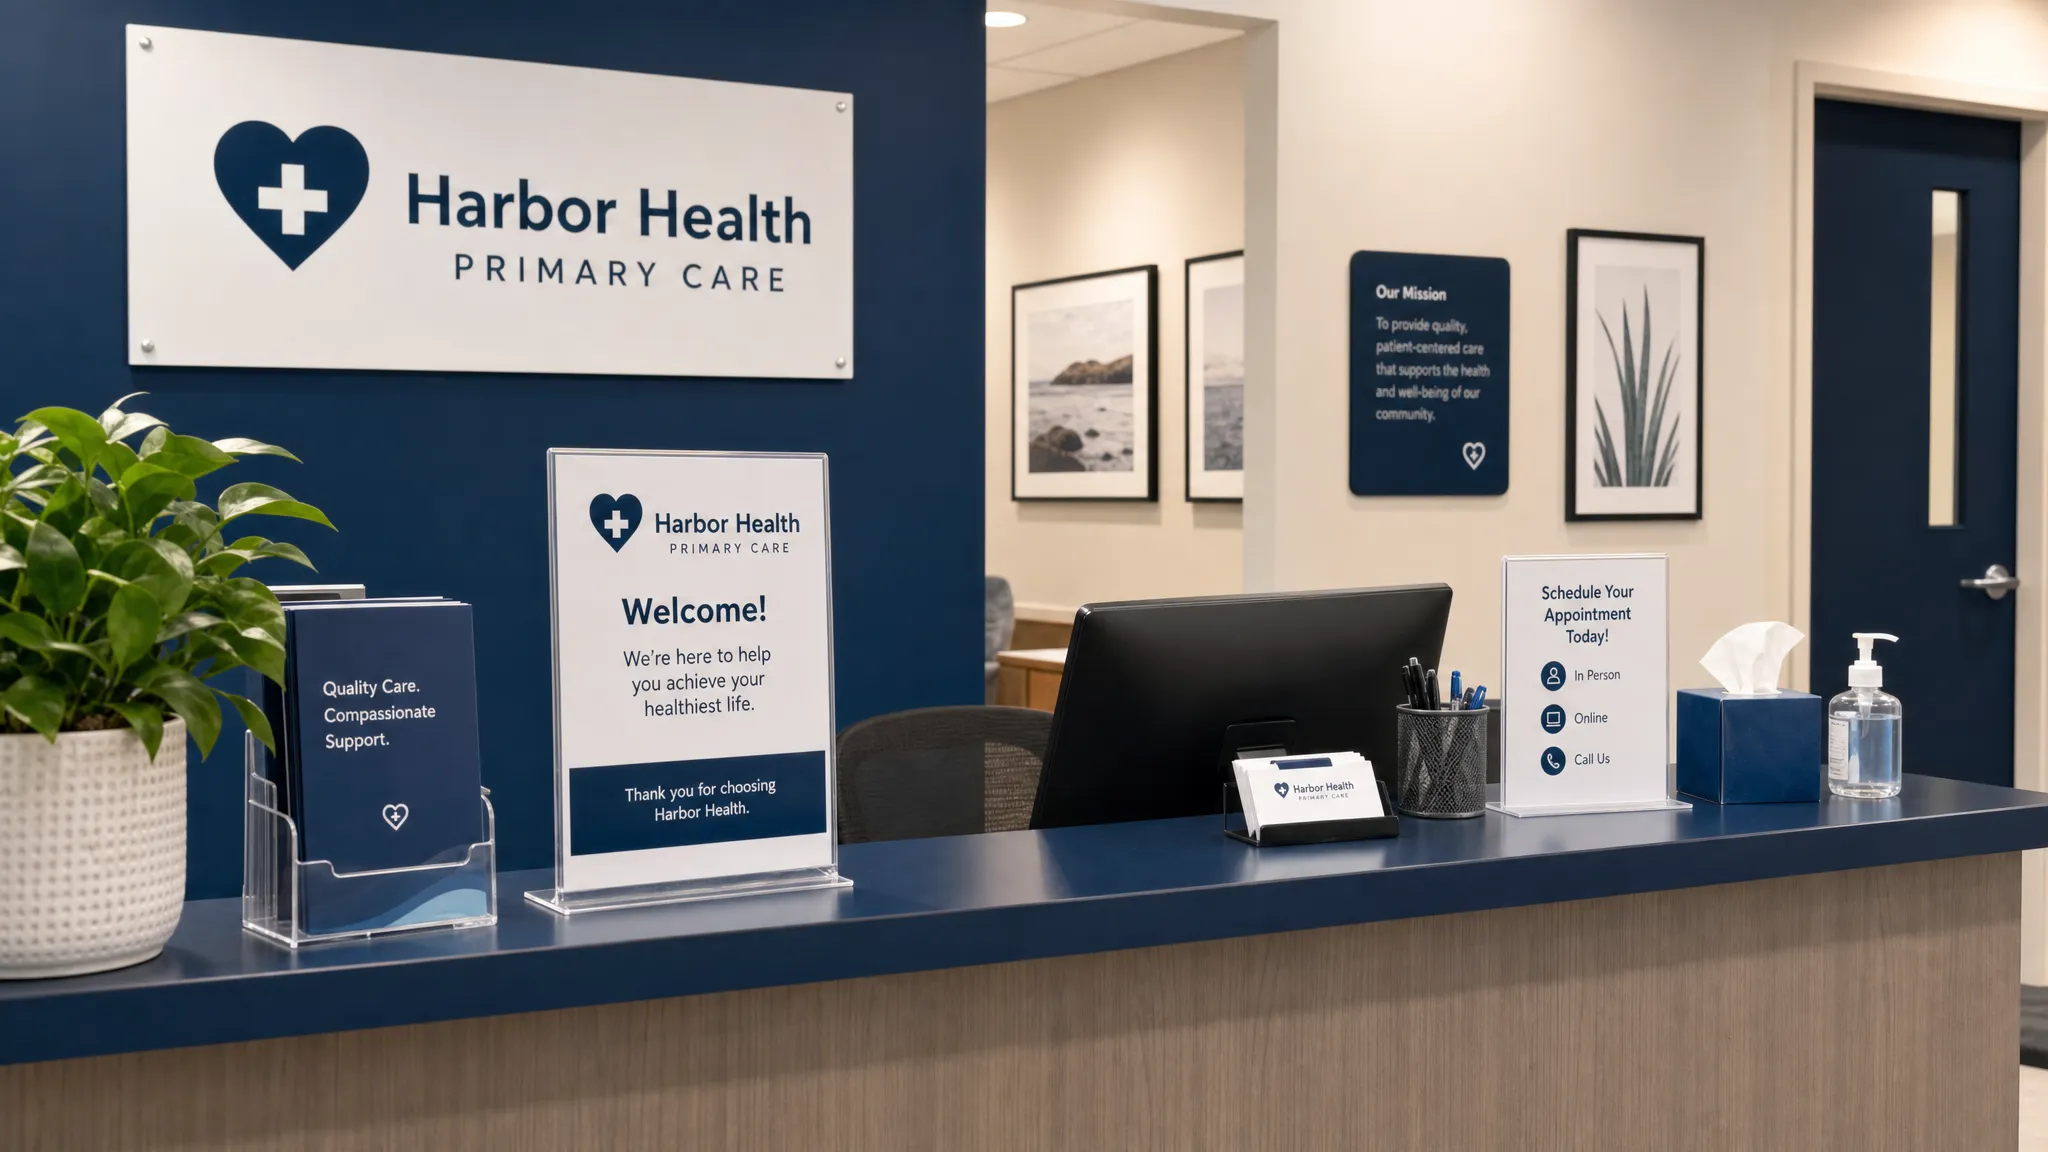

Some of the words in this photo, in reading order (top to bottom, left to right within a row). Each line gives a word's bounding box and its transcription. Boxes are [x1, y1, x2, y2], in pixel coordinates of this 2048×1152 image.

[408, 172, 617, 234] Harbor
[640, 187, 811, 245] Health
[455, 253, 656, 287] PRIMARY
[682, 263, 784, 293] CARE
[1376, 284, 1400, 298] Our
[1403, 286, 1446, 301] Mission
[1376, 317, 1389, 329] To
[1392, 319, 1430, 333] provide
[1432, 319, 1468, 335] quality,
[1376, 340, 1460, 355] patient-centered
[1463, 345, 1484, 355] care
[1376, 362, 1396, 375] that
[1399, 365, 1441, 379] supports
[1443, 364, 1459, 376] the
[1461, 364, 1490, 377] health
[1376, 385, 1395, 398] and
[1398, 386, 1449, 401] well-being
[1451, 385, 1461, 398] of
[1464, 389, 1480, 398] our
[1376, 407, 1435, 423] community.
[655, 512, 729, 534] Harbor
[736, 512, 800, 534] Health
[670, 543, 741, 553] PRIMARY
[751, 543, 788, 553] CARE
[1541, 584, 1602, 601] Schedule
[1605, 585, 1634, 598] Your
[621, 594, 766, 626] Welcome!
[1544, 606, 1632, 627] Appointment
[1565, 628, 1609, 647] Today!
[676, 647, 712, 665] here
[717, 649, 733, 662] to
[738, 645, 771, 666] help
[631, 679, 661, 697] you
[666, 672, 726, 691] achieve
[730, 674, 765, 692] your
[1575, 670, 1583, 681] In
[1588, 670, 1620, 680] Person
[322, 679, 378, 699] Quality
[382, 679, 419, 693] Care.
[644, 698, 722, 717] healthiest
[727, 694, 755, 712] life.
[324, 705, 437, 726] Compassionate
[1575, 712, 1608, 724] Online
[325, 732, 390, 752] Support.
[1575, 753, 1593, 765] Call
[1598, 753, 1610, 764] Us
[624, 785, 666, 802] Thank
[670, 788, 693, 802] you
[698, 782, 716, 796] for
[720, 778, 777, 795] choosing
[1293, 784, 1323, 793] Harbor
[1326, 781, 1354, 791] Health
[654, 805, 702, 822] Harbor
[705, 800, 750, 818] Health.
